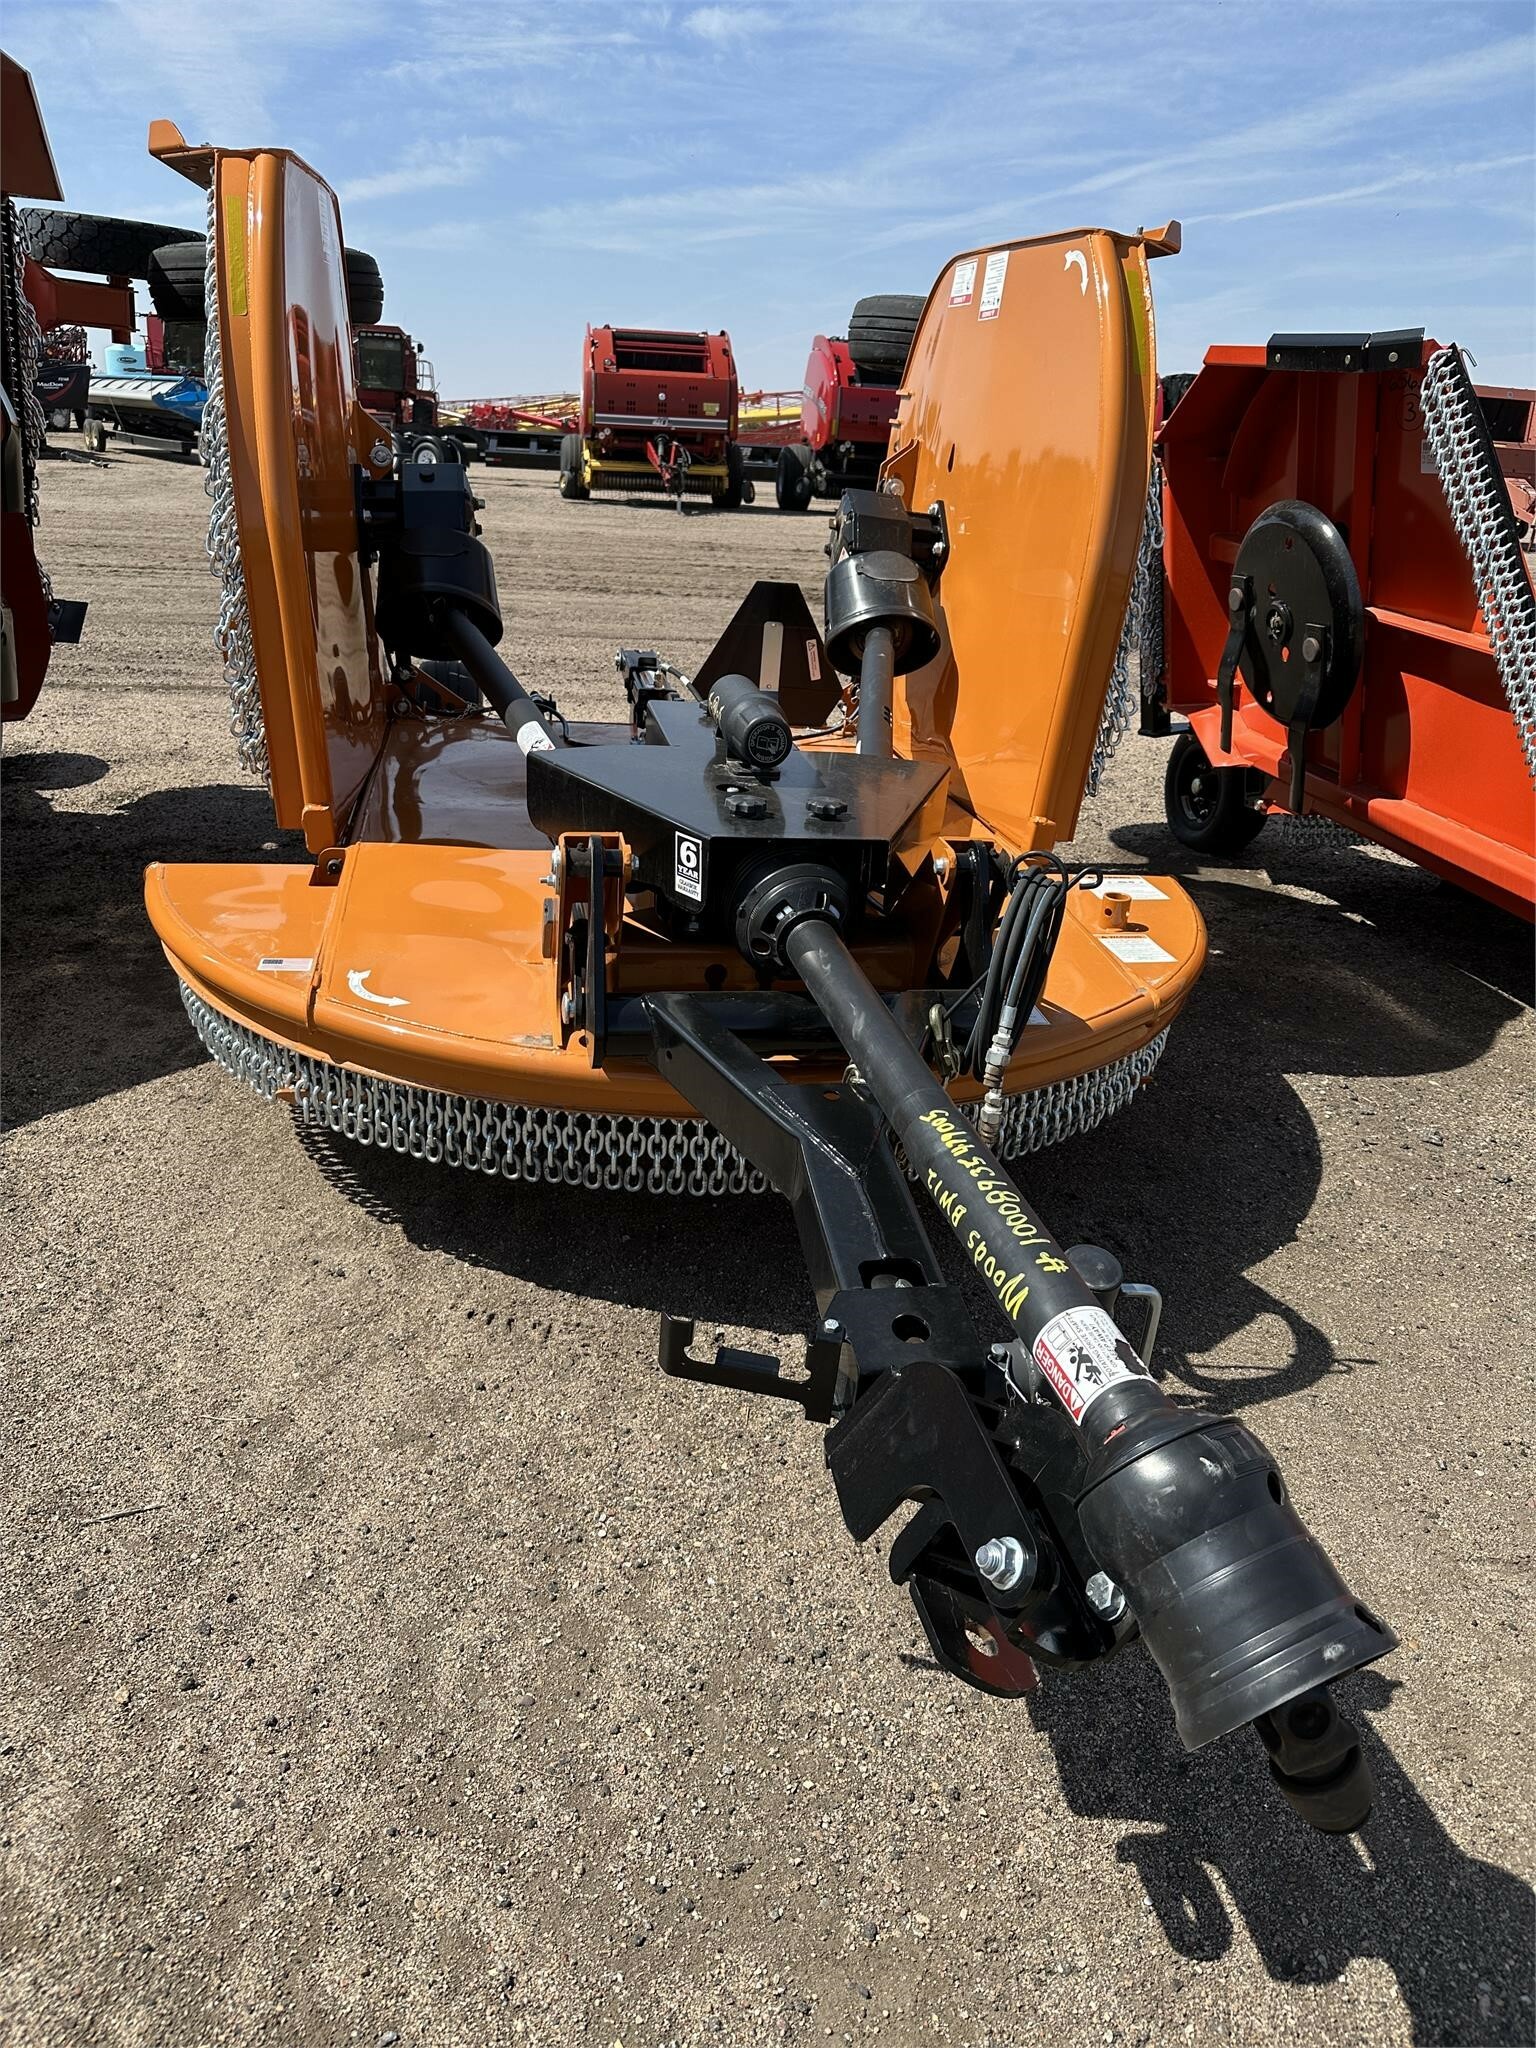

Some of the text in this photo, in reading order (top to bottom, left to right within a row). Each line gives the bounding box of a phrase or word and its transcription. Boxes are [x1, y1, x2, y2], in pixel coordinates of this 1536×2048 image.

[1404, 402, 1417, 422] 3
[680, 840, 698, 869] 6
[677, 864, 699, 880] YEAR
[967, 1230, 1030, 1320] Woods
[1067, 1315, 1083, 1333] SHAFT
[1080, 1332, 1095, 1350] DRIVE
[1034, 1342, 1072, 1397] DANGER
[1091, 1348, 1115, 1376] ROTATING
